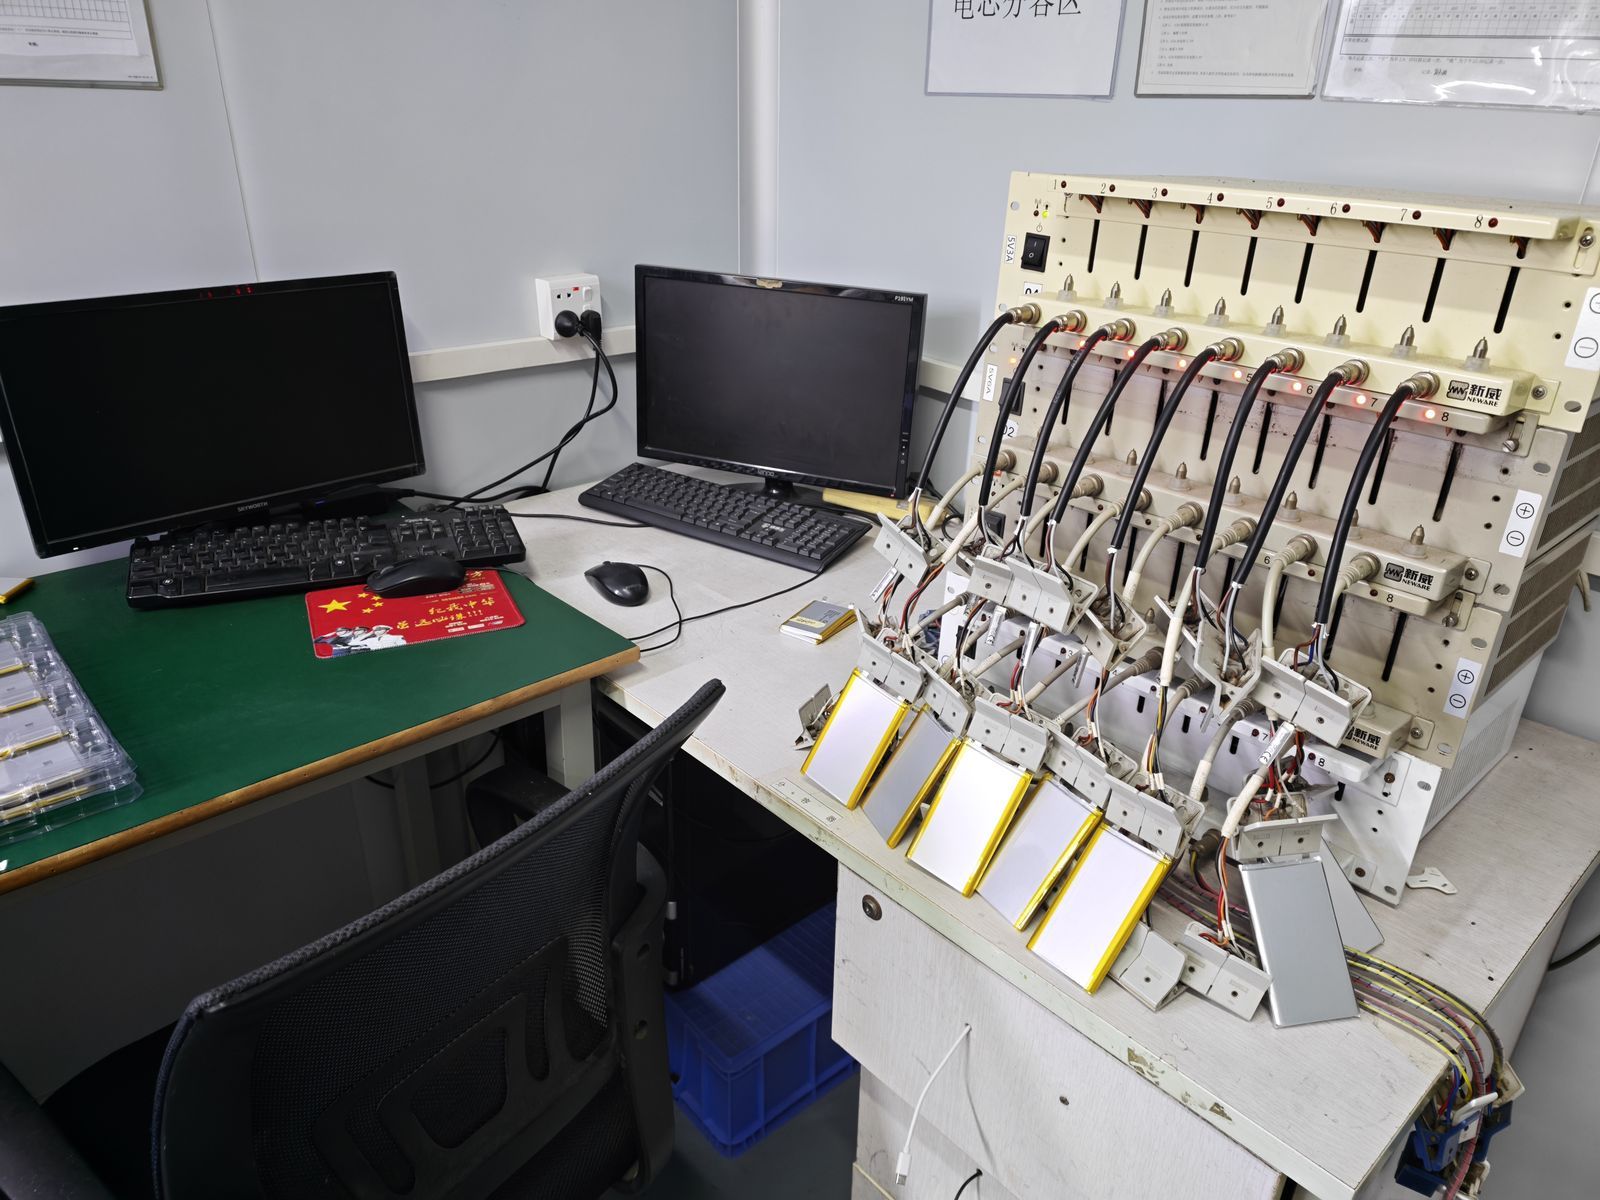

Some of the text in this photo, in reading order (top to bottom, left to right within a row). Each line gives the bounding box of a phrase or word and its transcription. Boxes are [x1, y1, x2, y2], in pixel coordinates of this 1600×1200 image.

[1100, 183, 1107, 194] 2
[1151, 187, 1158, 198] 3
[1206, 192, 1213, 204] 4
[1265, 197, 1273, 208] 5
[1330, 203, 1337, 215] 6
[1400, 208, 1408, 221] 7
[1474, 215, 1484, 228] 8
[1006, 237, 1016, 262] 5V3A
[1467, 396, 1499, 407] NEWARE
[1469, 384, 1503, 400] 新威
[1306, 385, 1314, 395] 6
[1370, 397, 1378, 407] 7
[1441, 411, 1450, 422] 8
[1263, 555, 1394, 603] 6 8
[1401, 578, 1431, 591] NEWARE
[1404, 568, 1434, 586] 新威
[1352, 736, 1378, 750] NEWARE
[1353, 727, 1382, 746] 新威
[1262, 732, 1269, 741] 7
[1318, 757, 1326, 767] 8
